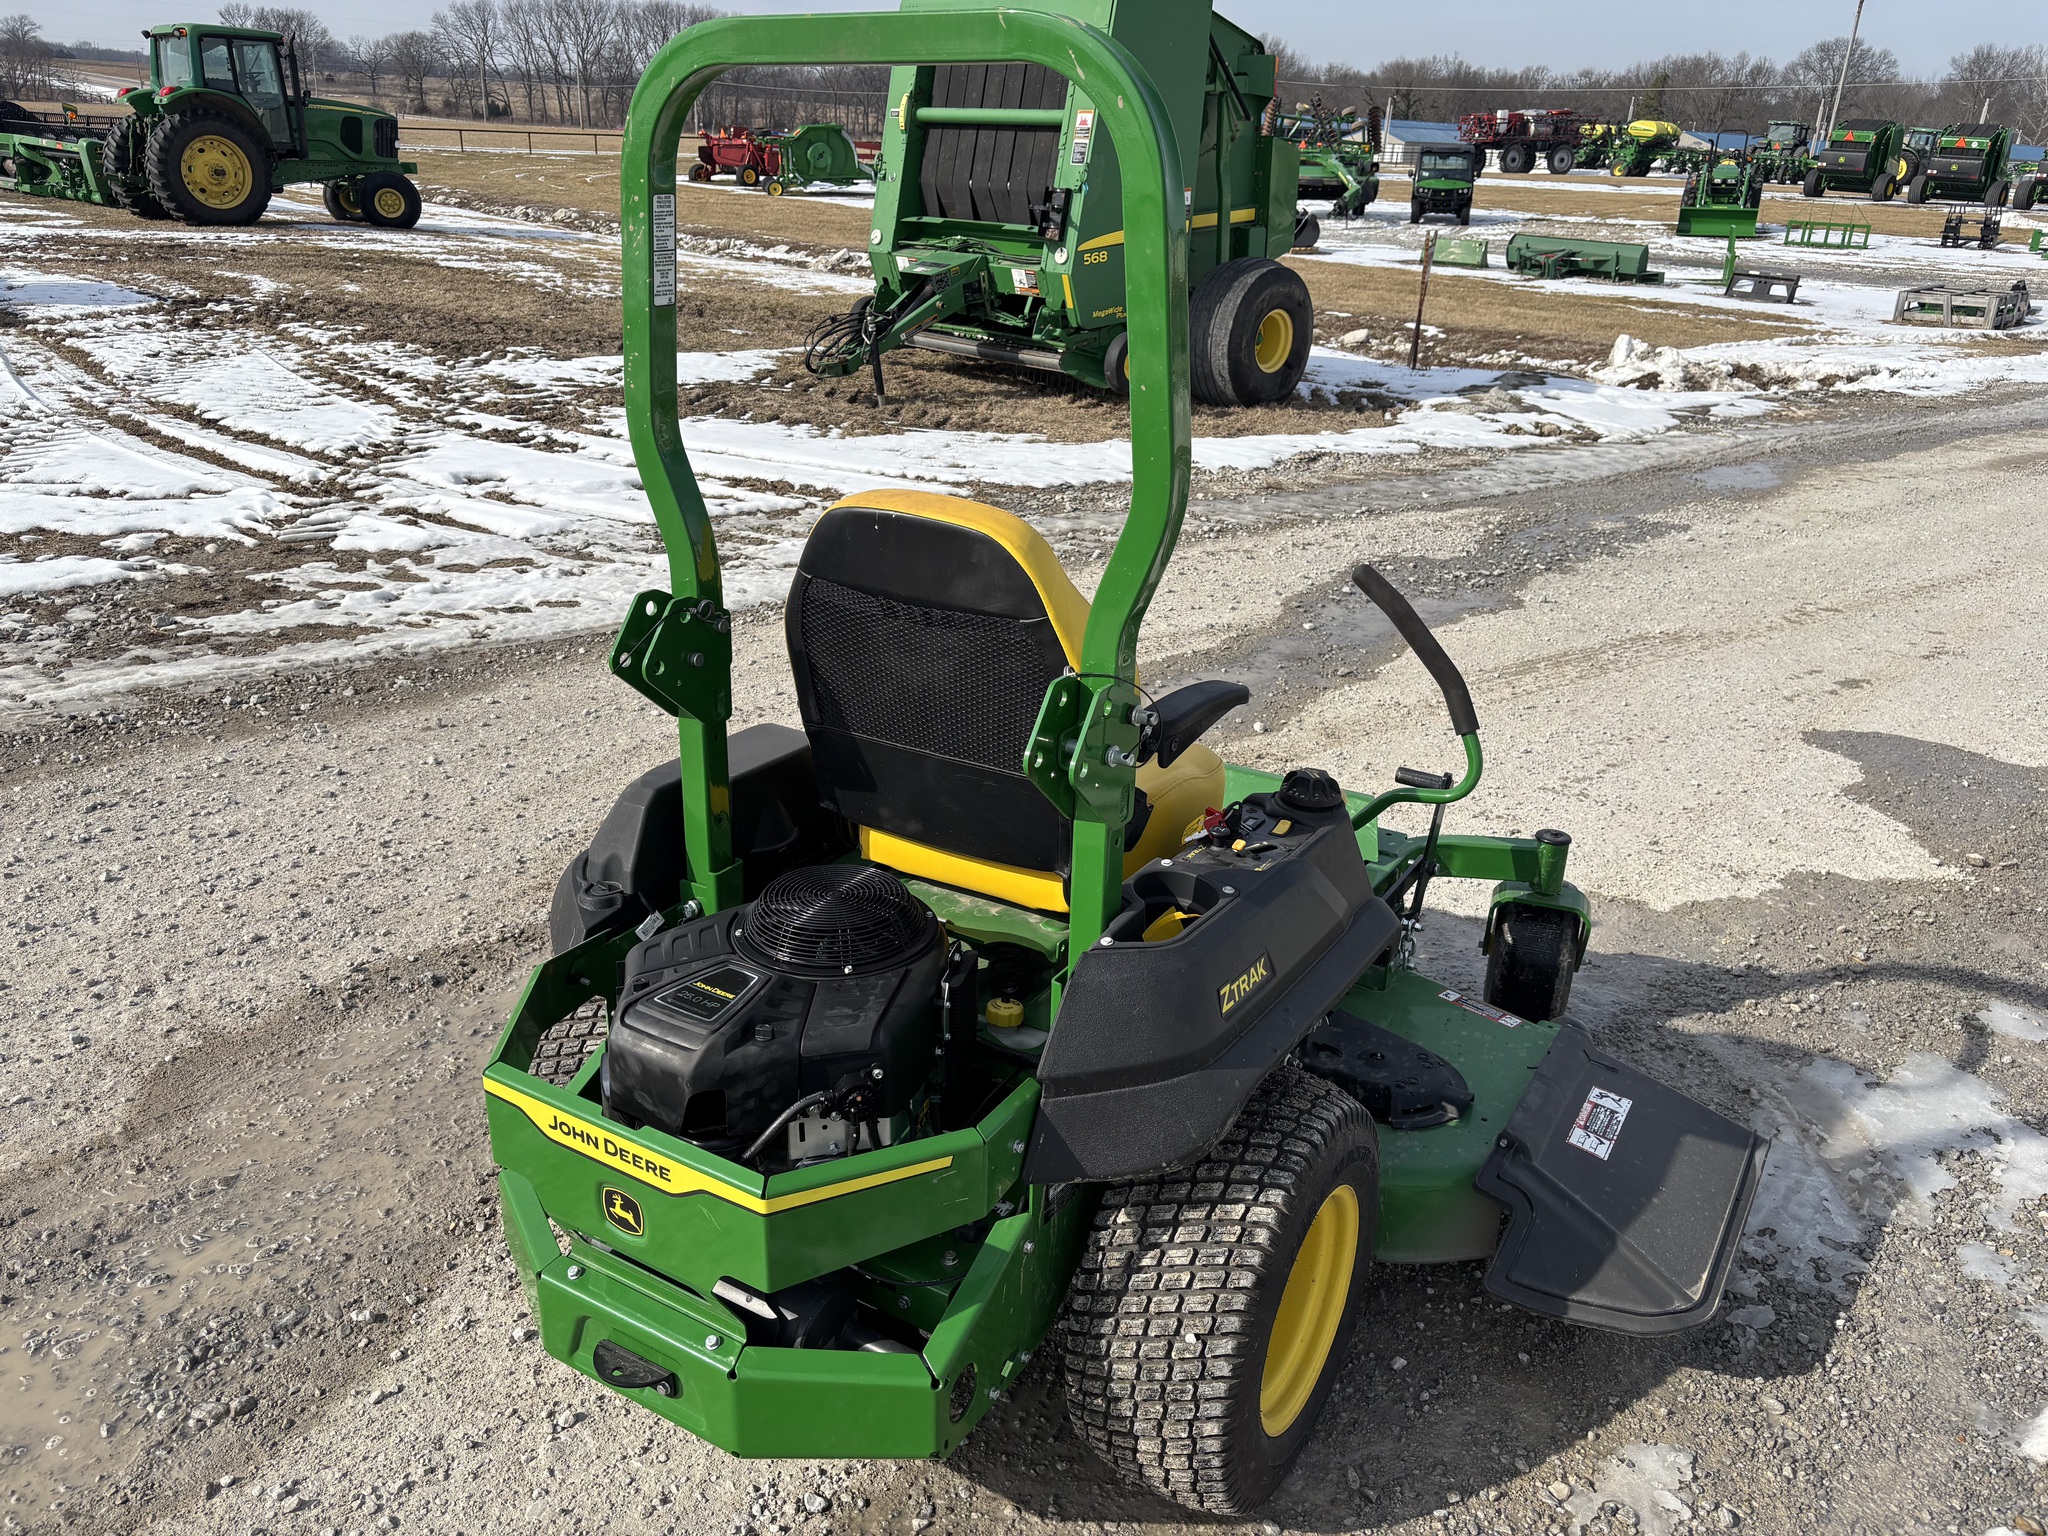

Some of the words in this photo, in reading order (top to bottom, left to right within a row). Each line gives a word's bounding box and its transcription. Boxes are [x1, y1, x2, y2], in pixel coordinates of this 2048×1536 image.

[1083, 250, 1108, 265] 568
[1092, 306, 1123, 318] MegaWide
[692, 981, 712, 992] JOHN
[711, 987, 736, 999] DEERE
[1220, 957, 1267, 1014] ZTRAK
[677, 990, 702, 1003] 25.0
[701, 999, 720, 1008] HP
[548, 1115, 599, 1150] JOHN
[603, 1137, 671, 1182] DEERE
